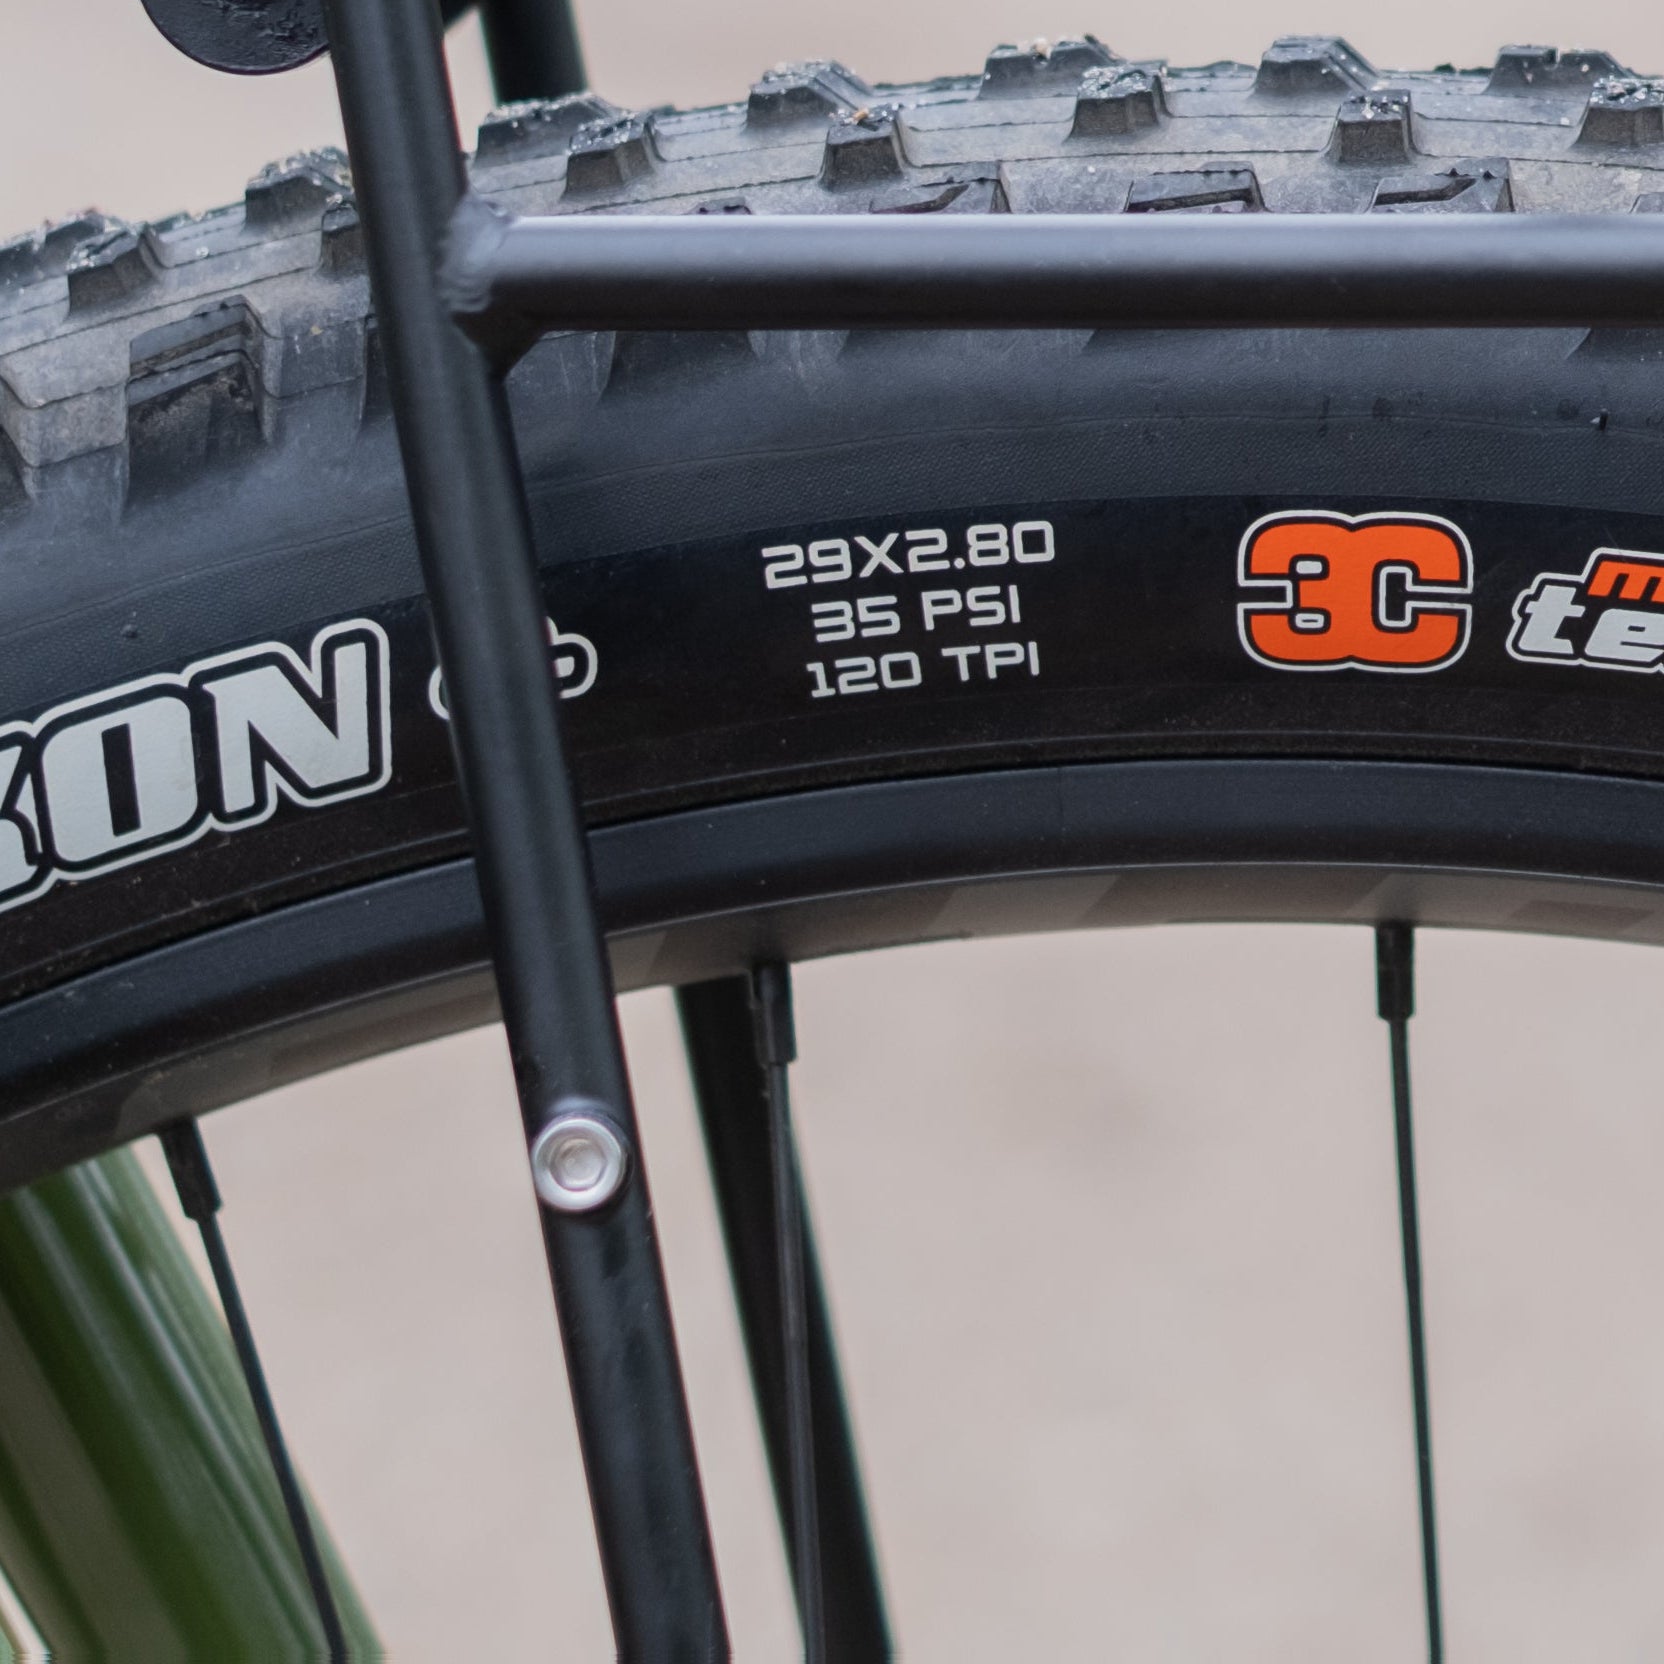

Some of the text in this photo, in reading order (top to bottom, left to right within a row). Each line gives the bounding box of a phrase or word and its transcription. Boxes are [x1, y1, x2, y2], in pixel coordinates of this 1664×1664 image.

[762, 520, 1055, 590] 29X2.80
[811, 585, 1021, 642] 35 PSI
[1238, 510, 1474, 674] 3C
[806, 641, 1040, 698] 120 TPI
[0, 626, 384, 901] ON
